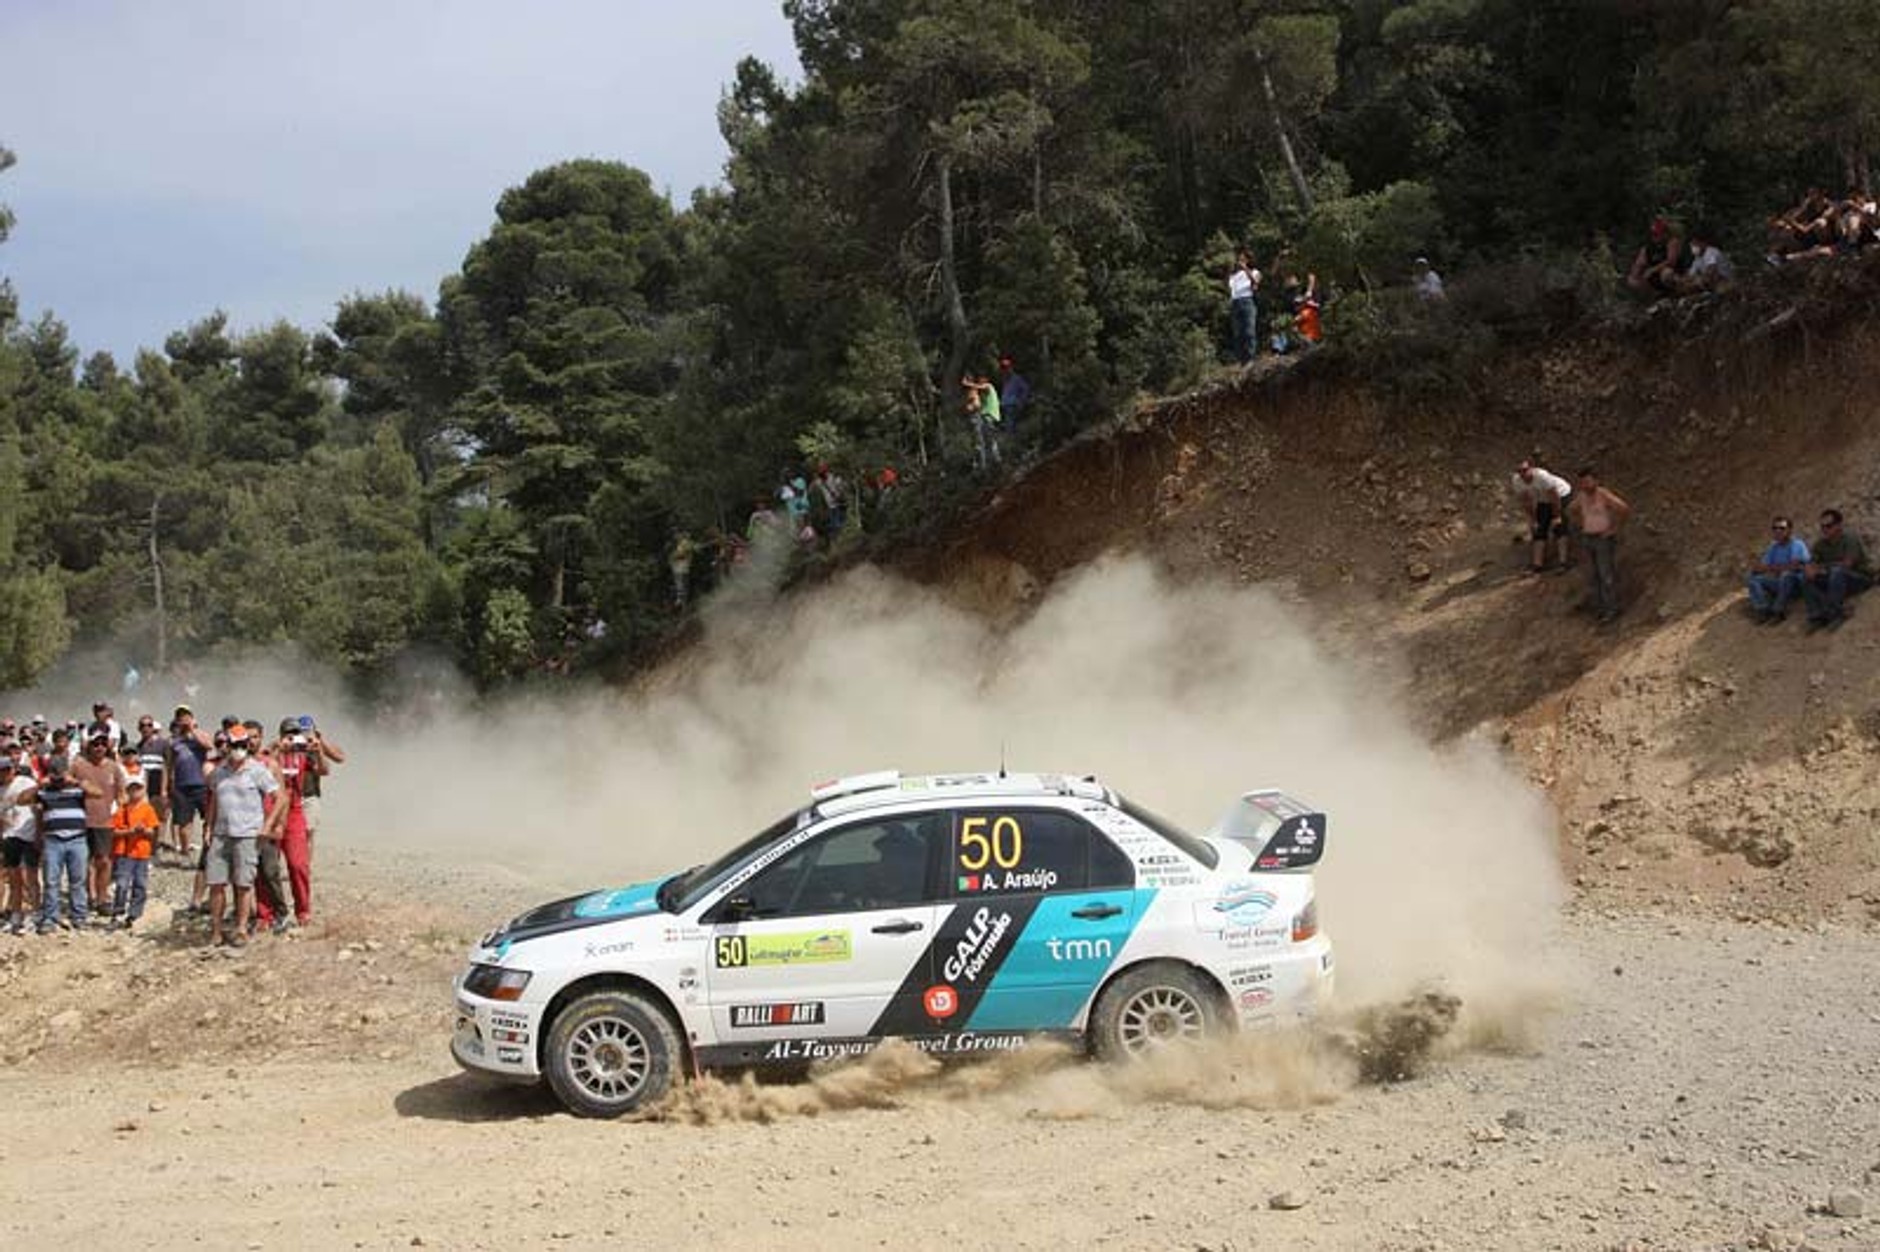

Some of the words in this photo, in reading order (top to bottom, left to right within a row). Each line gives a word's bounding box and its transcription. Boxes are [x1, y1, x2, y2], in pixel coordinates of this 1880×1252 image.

[960, 816, 1022, 870] 50
[982, 874, 998, 890] A.
[1004, 868, 1058, 889] Araújo
[718, 937, 744, 967] 50
[944, 907, 990, 982] GALP
[1046, 936, 1112, 961] tmn
[765, 1039, 875, 1059] Al-Tayyar
[956, 1031, 1025, 1054] Group
